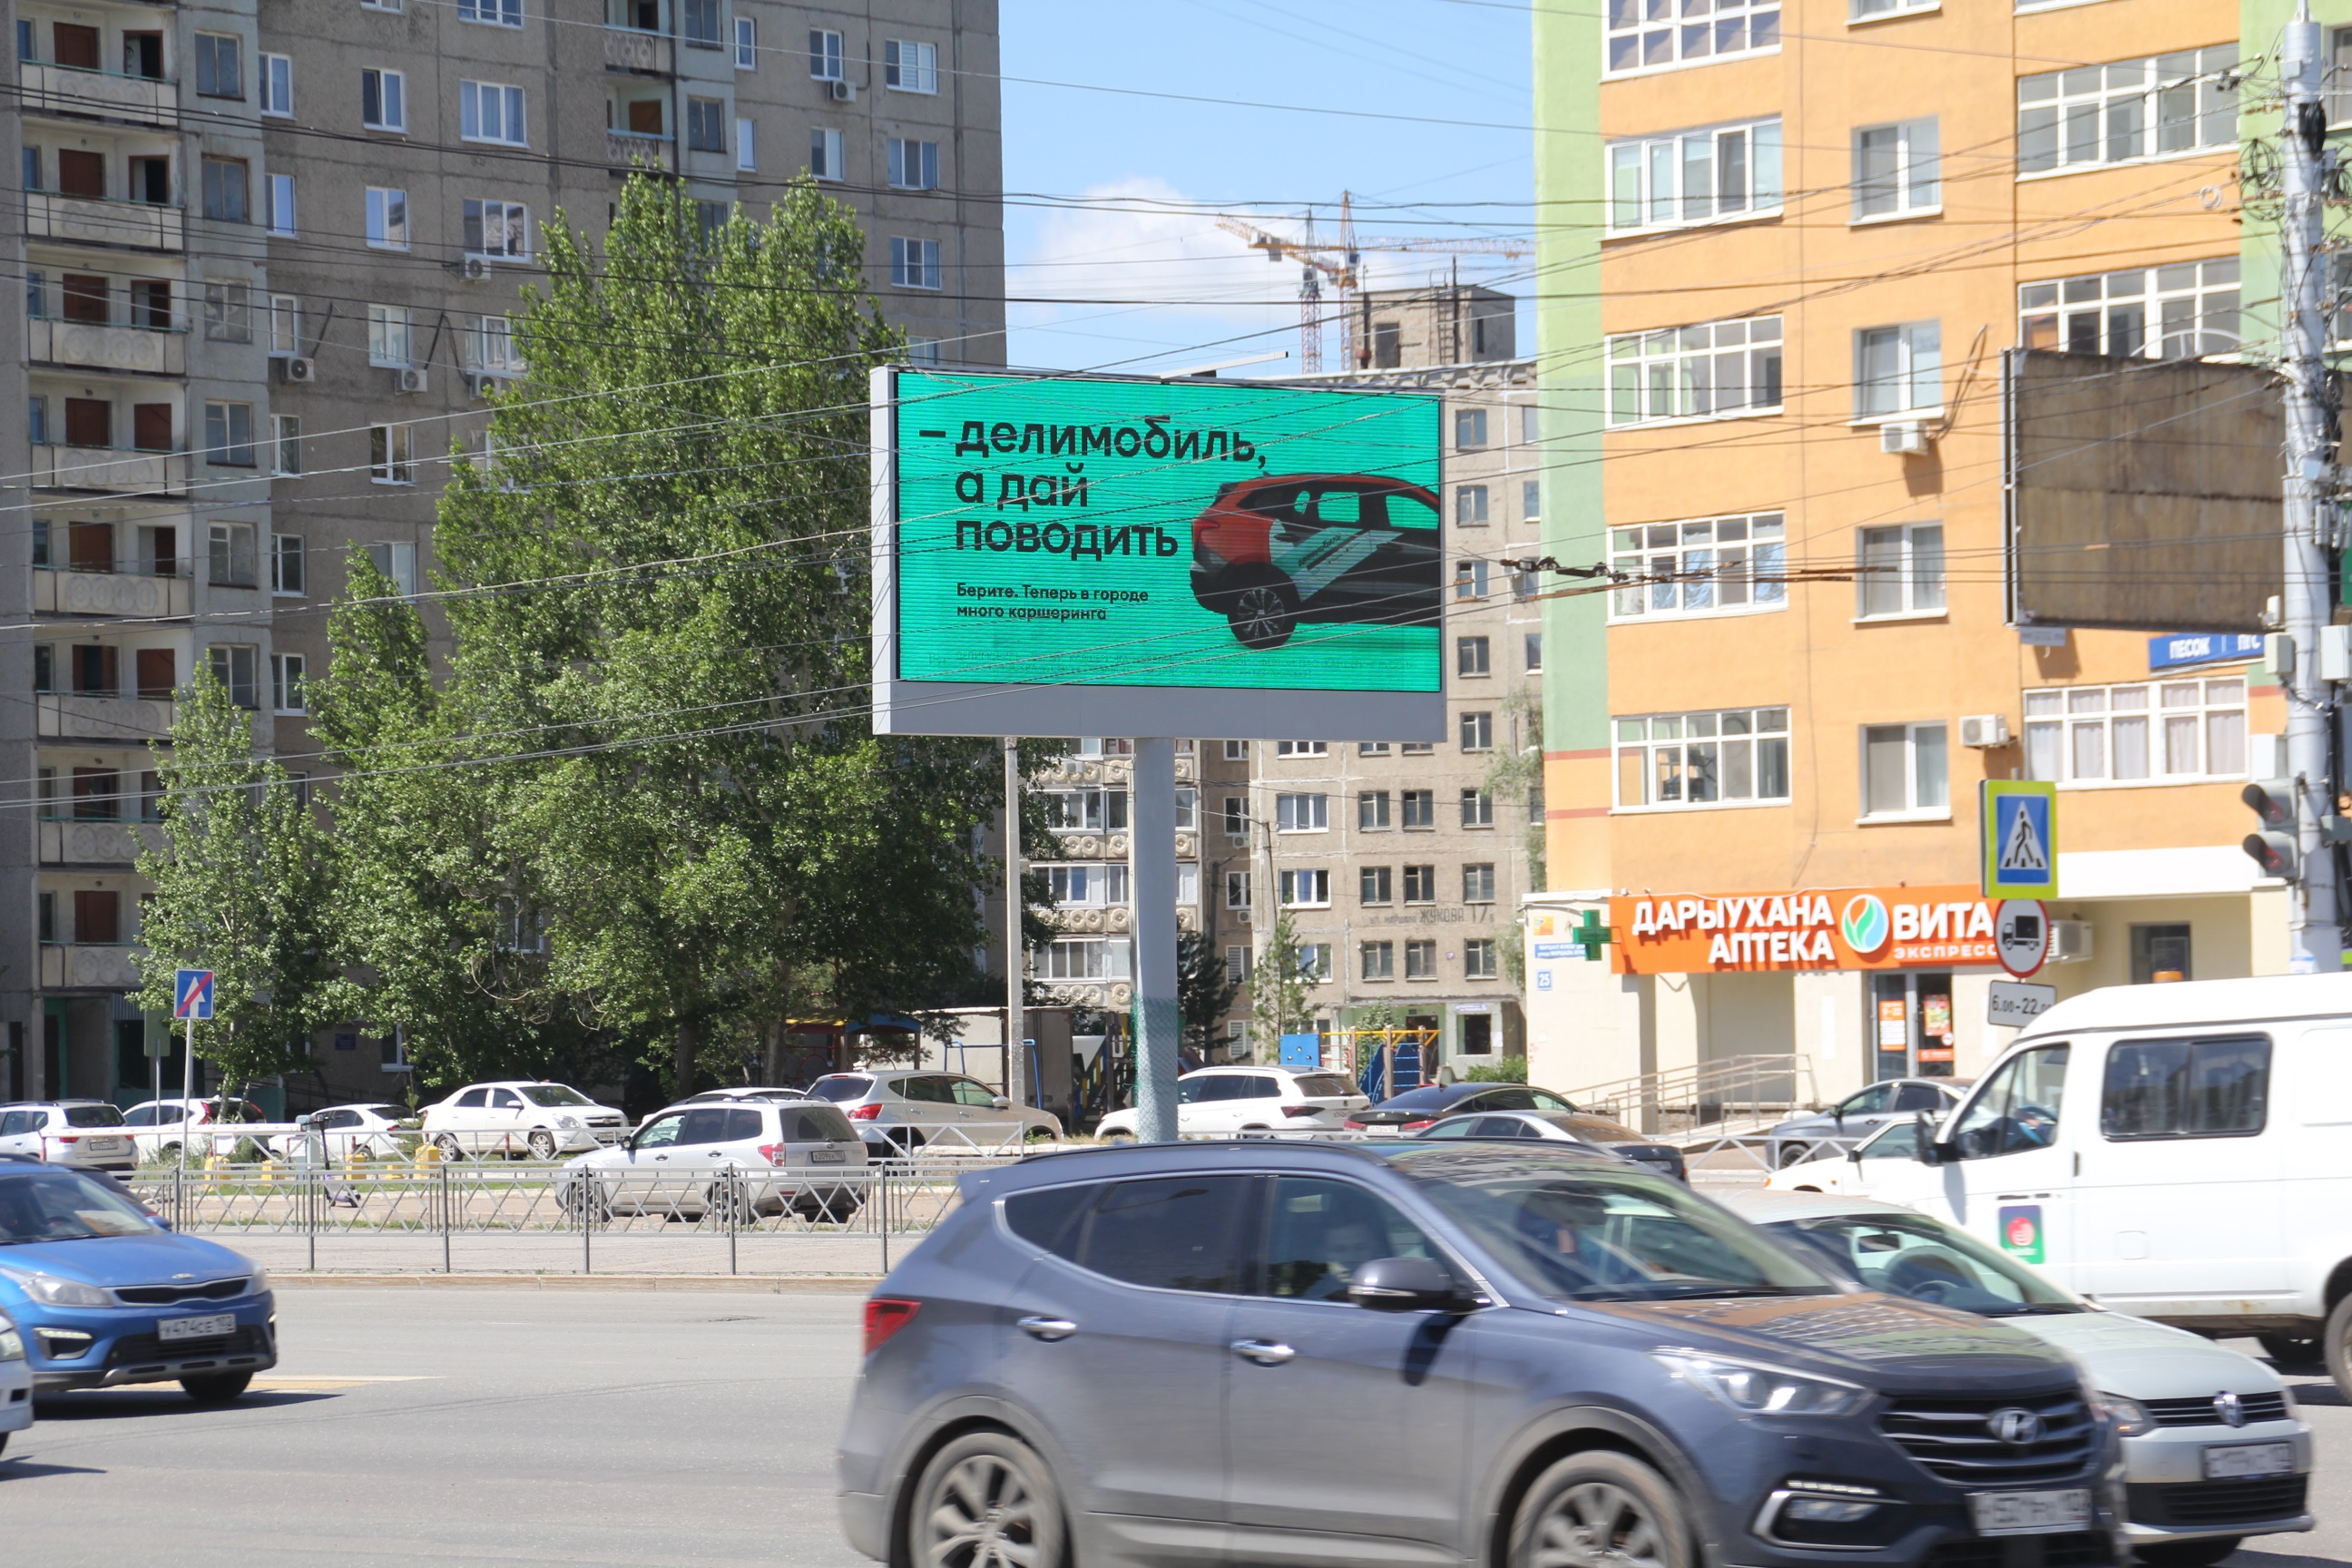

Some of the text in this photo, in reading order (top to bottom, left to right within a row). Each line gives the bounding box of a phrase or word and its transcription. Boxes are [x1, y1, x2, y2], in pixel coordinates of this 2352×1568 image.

[956, 416, 1266, 469] делимобиль,
[956, 461, 1088, 512] а дай
[956, 520, 1179, 562] поводить
[956, 583, 1149, 603] Берите. Теперь в городе
[956, 605, 1107, 623] много каршеринга
[2169, 636, 2211, 660] ПЕСОК
[1419, 906, 1465, 923] ЖУКОВА
[1632, 895, 1994, 941] ДАРЫУХАНА ВИТА
[1708, 930, 1836, 964] АПТЕКА
[1893, 943, 1997, 959] ЭКСПРЕСС
[1539, 973, 1551, 987] 25
